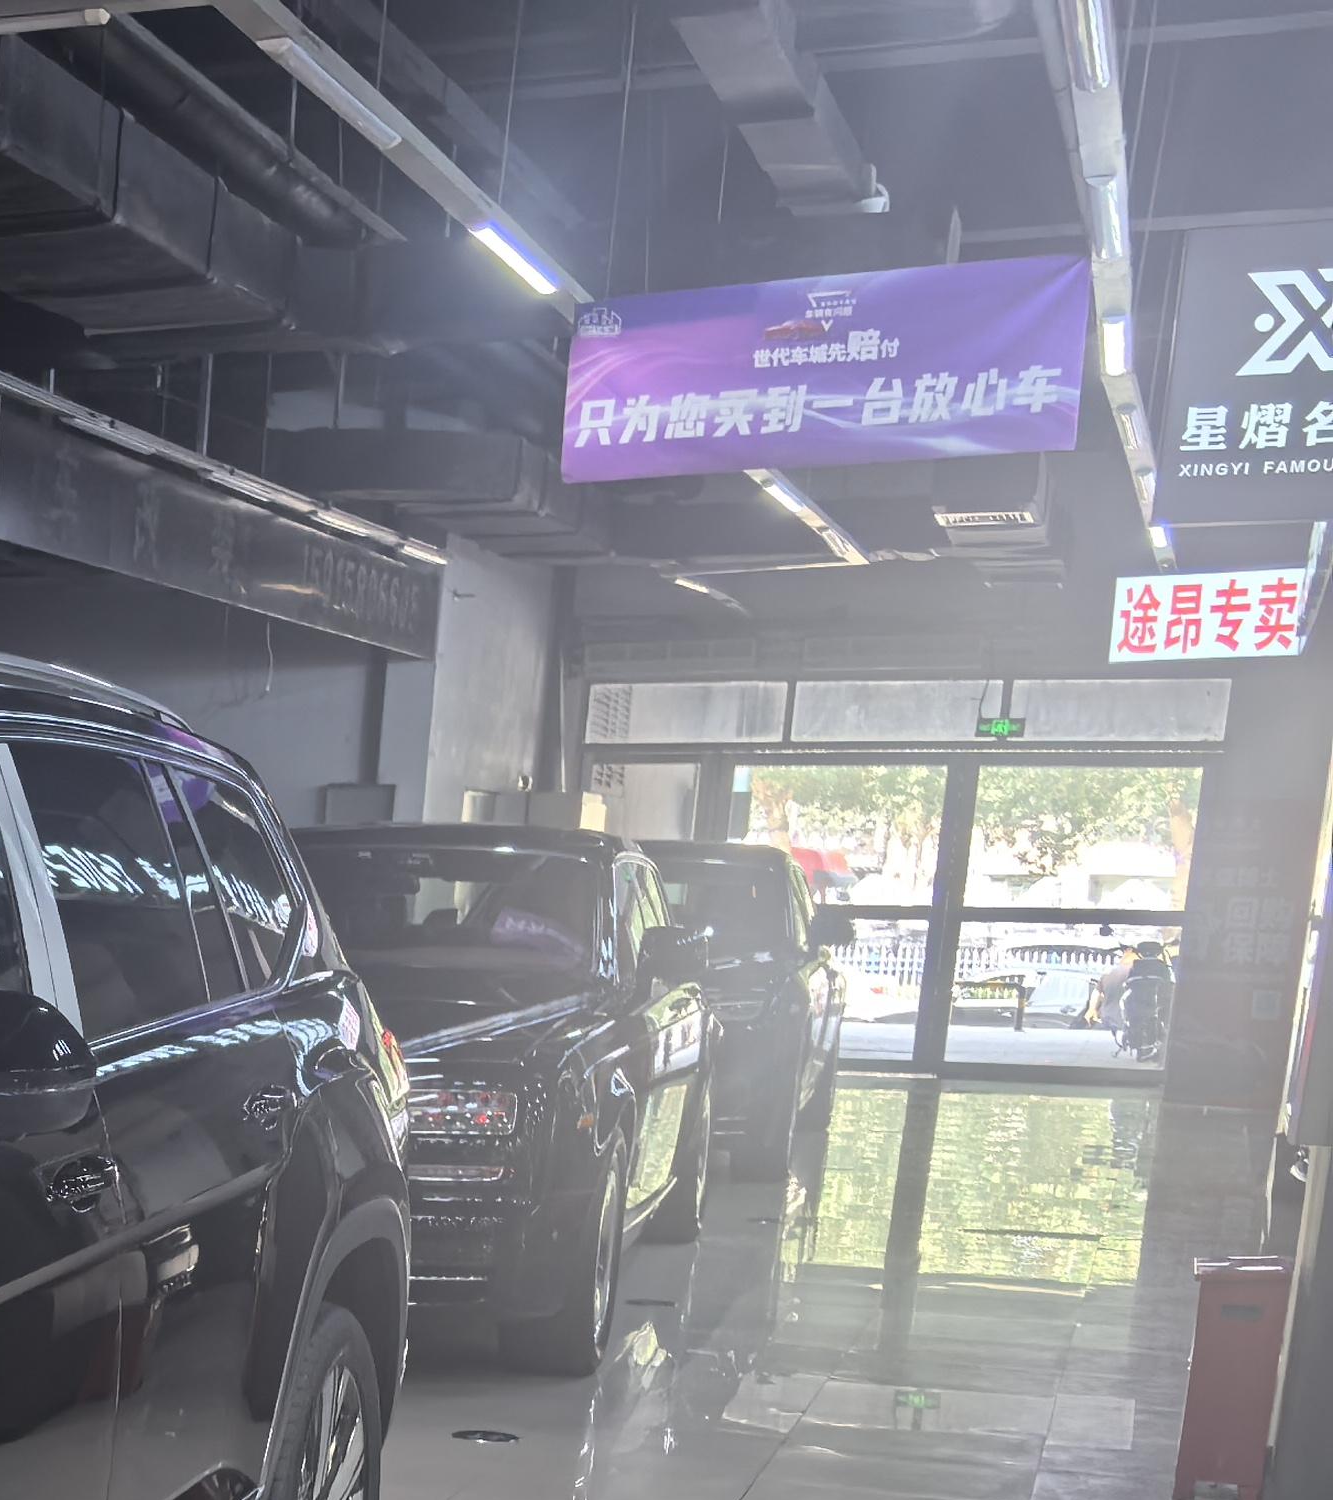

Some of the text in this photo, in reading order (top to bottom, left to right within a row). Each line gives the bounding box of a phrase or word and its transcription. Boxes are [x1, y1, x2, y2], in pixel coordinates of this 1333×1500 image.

[753, 328, 900, 369] 世代车城先赔付
[574, 364, 1063, 448] 只为您买到一台放心车
[1179, 400, 1333, 452] 星熠名
[1178, 461, 1250, 478] XINGYI
[1117, 577, 1299, 655] 途昂专卖
